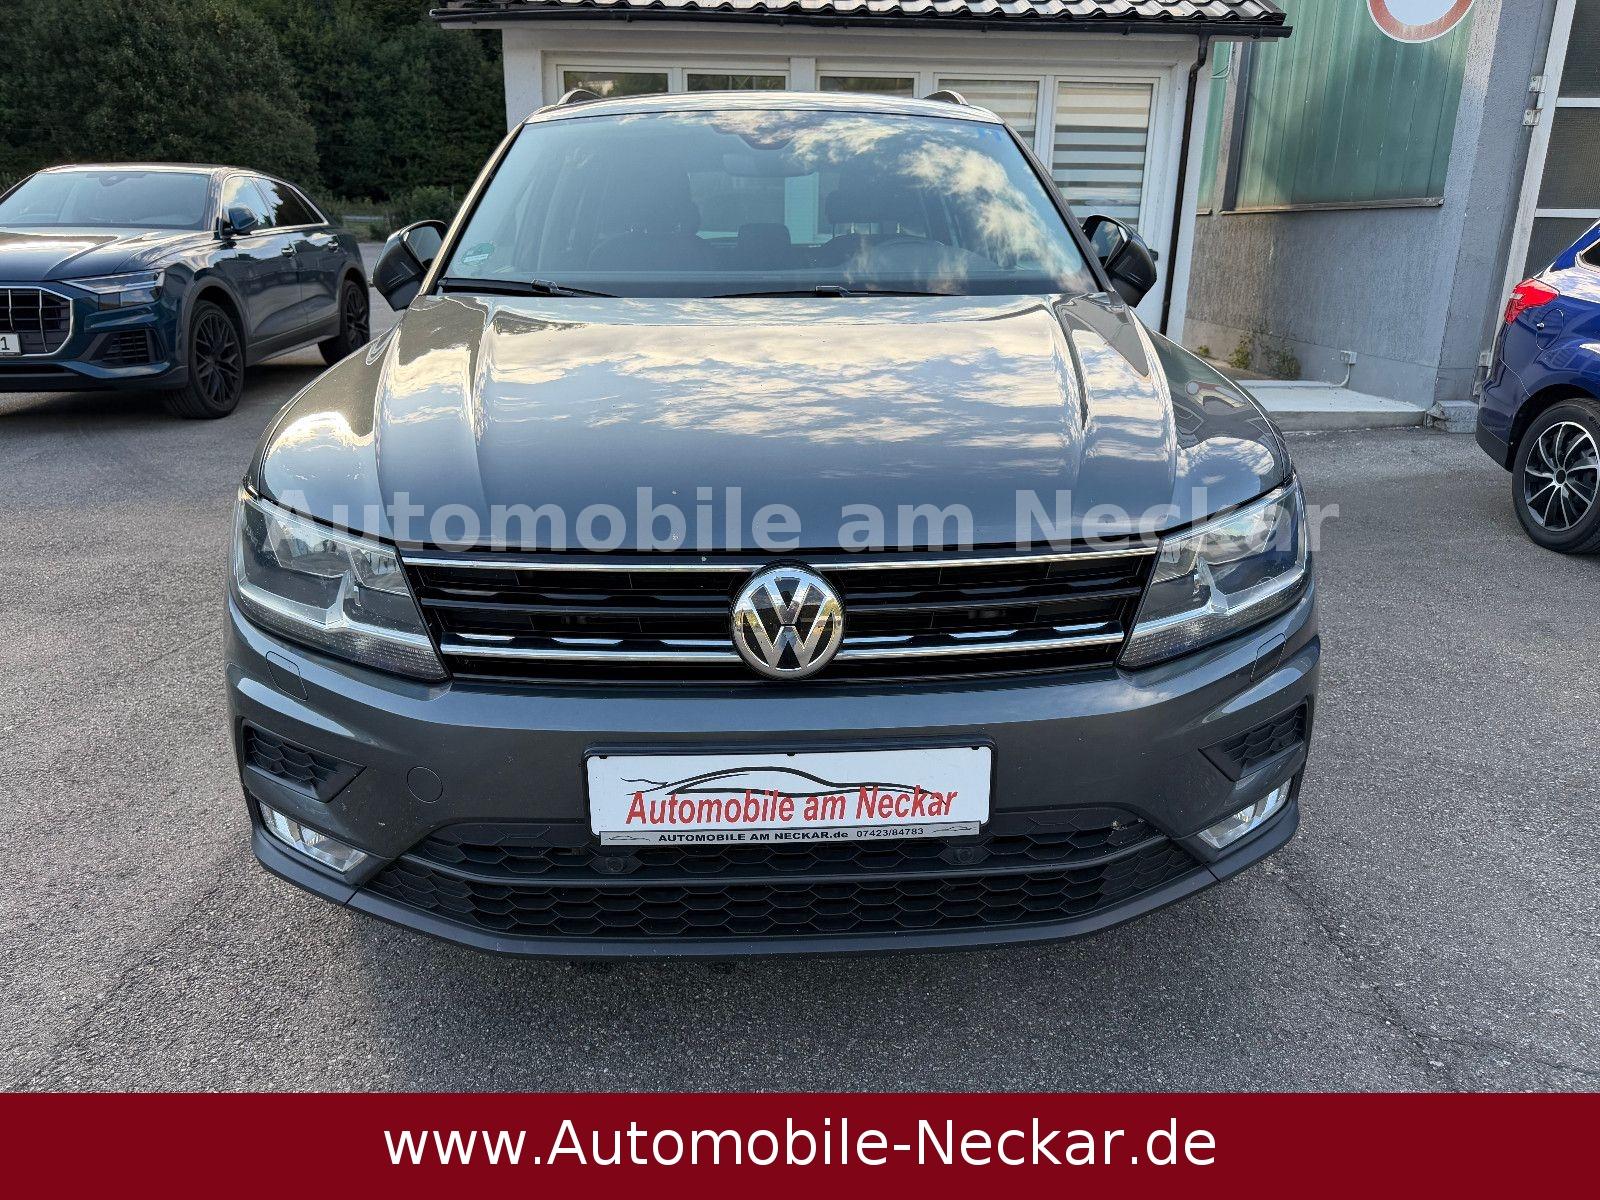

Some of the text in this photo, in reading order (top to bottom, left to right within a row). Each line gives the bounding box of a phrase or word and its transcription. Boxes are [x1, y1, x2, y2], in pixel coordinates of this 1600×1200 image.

[733, 568, 841, 677] VW
[626, 785, 958, 824] Automobile am Neckar
[658, 828, 924, 842] AUTOMOBILE AM NECKAR.de 07423/84783
